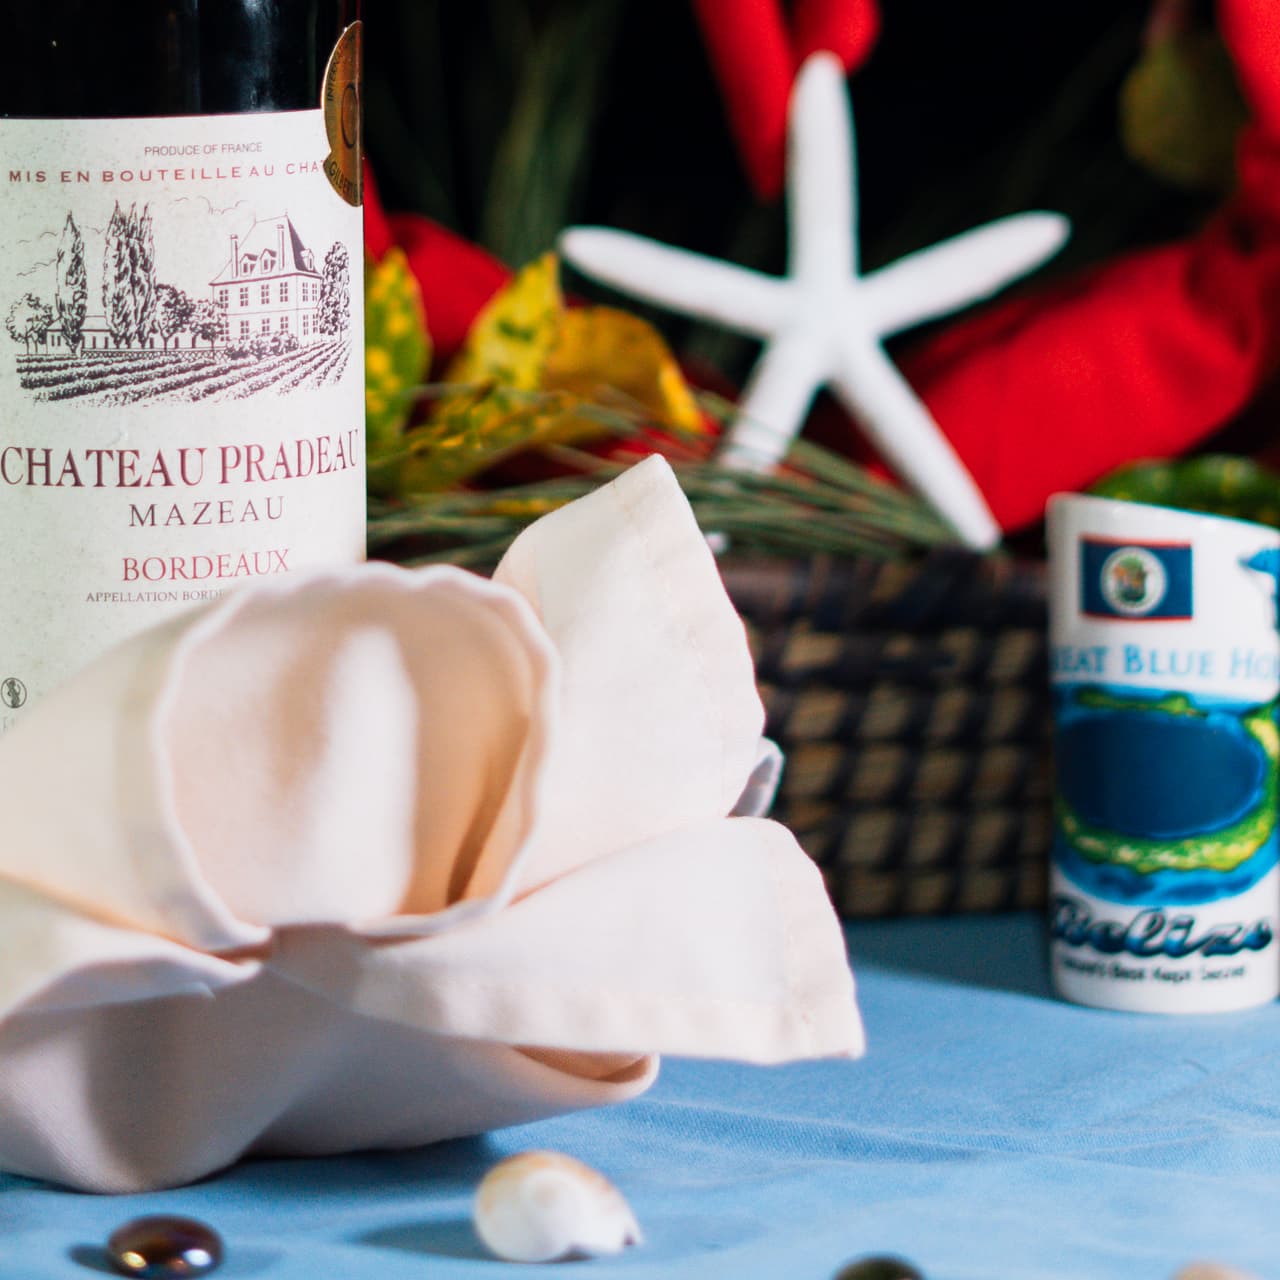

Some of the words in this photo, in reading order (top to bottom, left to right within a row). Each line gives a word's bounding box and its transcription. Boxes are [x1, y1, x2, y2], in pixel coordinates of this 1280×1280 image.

[144, 145, 200, 157] PRODUCE
[203, 144, 218, 156] OF
[221, 142, 263, 154] FRANCE
[9, 170, 47, 183] MIS
[60, 170, 90, 183] EN
[102, 167, 241, 183] BOUTEILLE
[249, 164, 274, 177] AU
[0, 446, 208, 488] CHATEAU
[217, 428, 360, 486] PRADEAU
[128, 496, 285, 528] MAZEAU
[122, 548, 291, 582] BORDEAUX
[86, 591, 178, 603] APPELLATION
